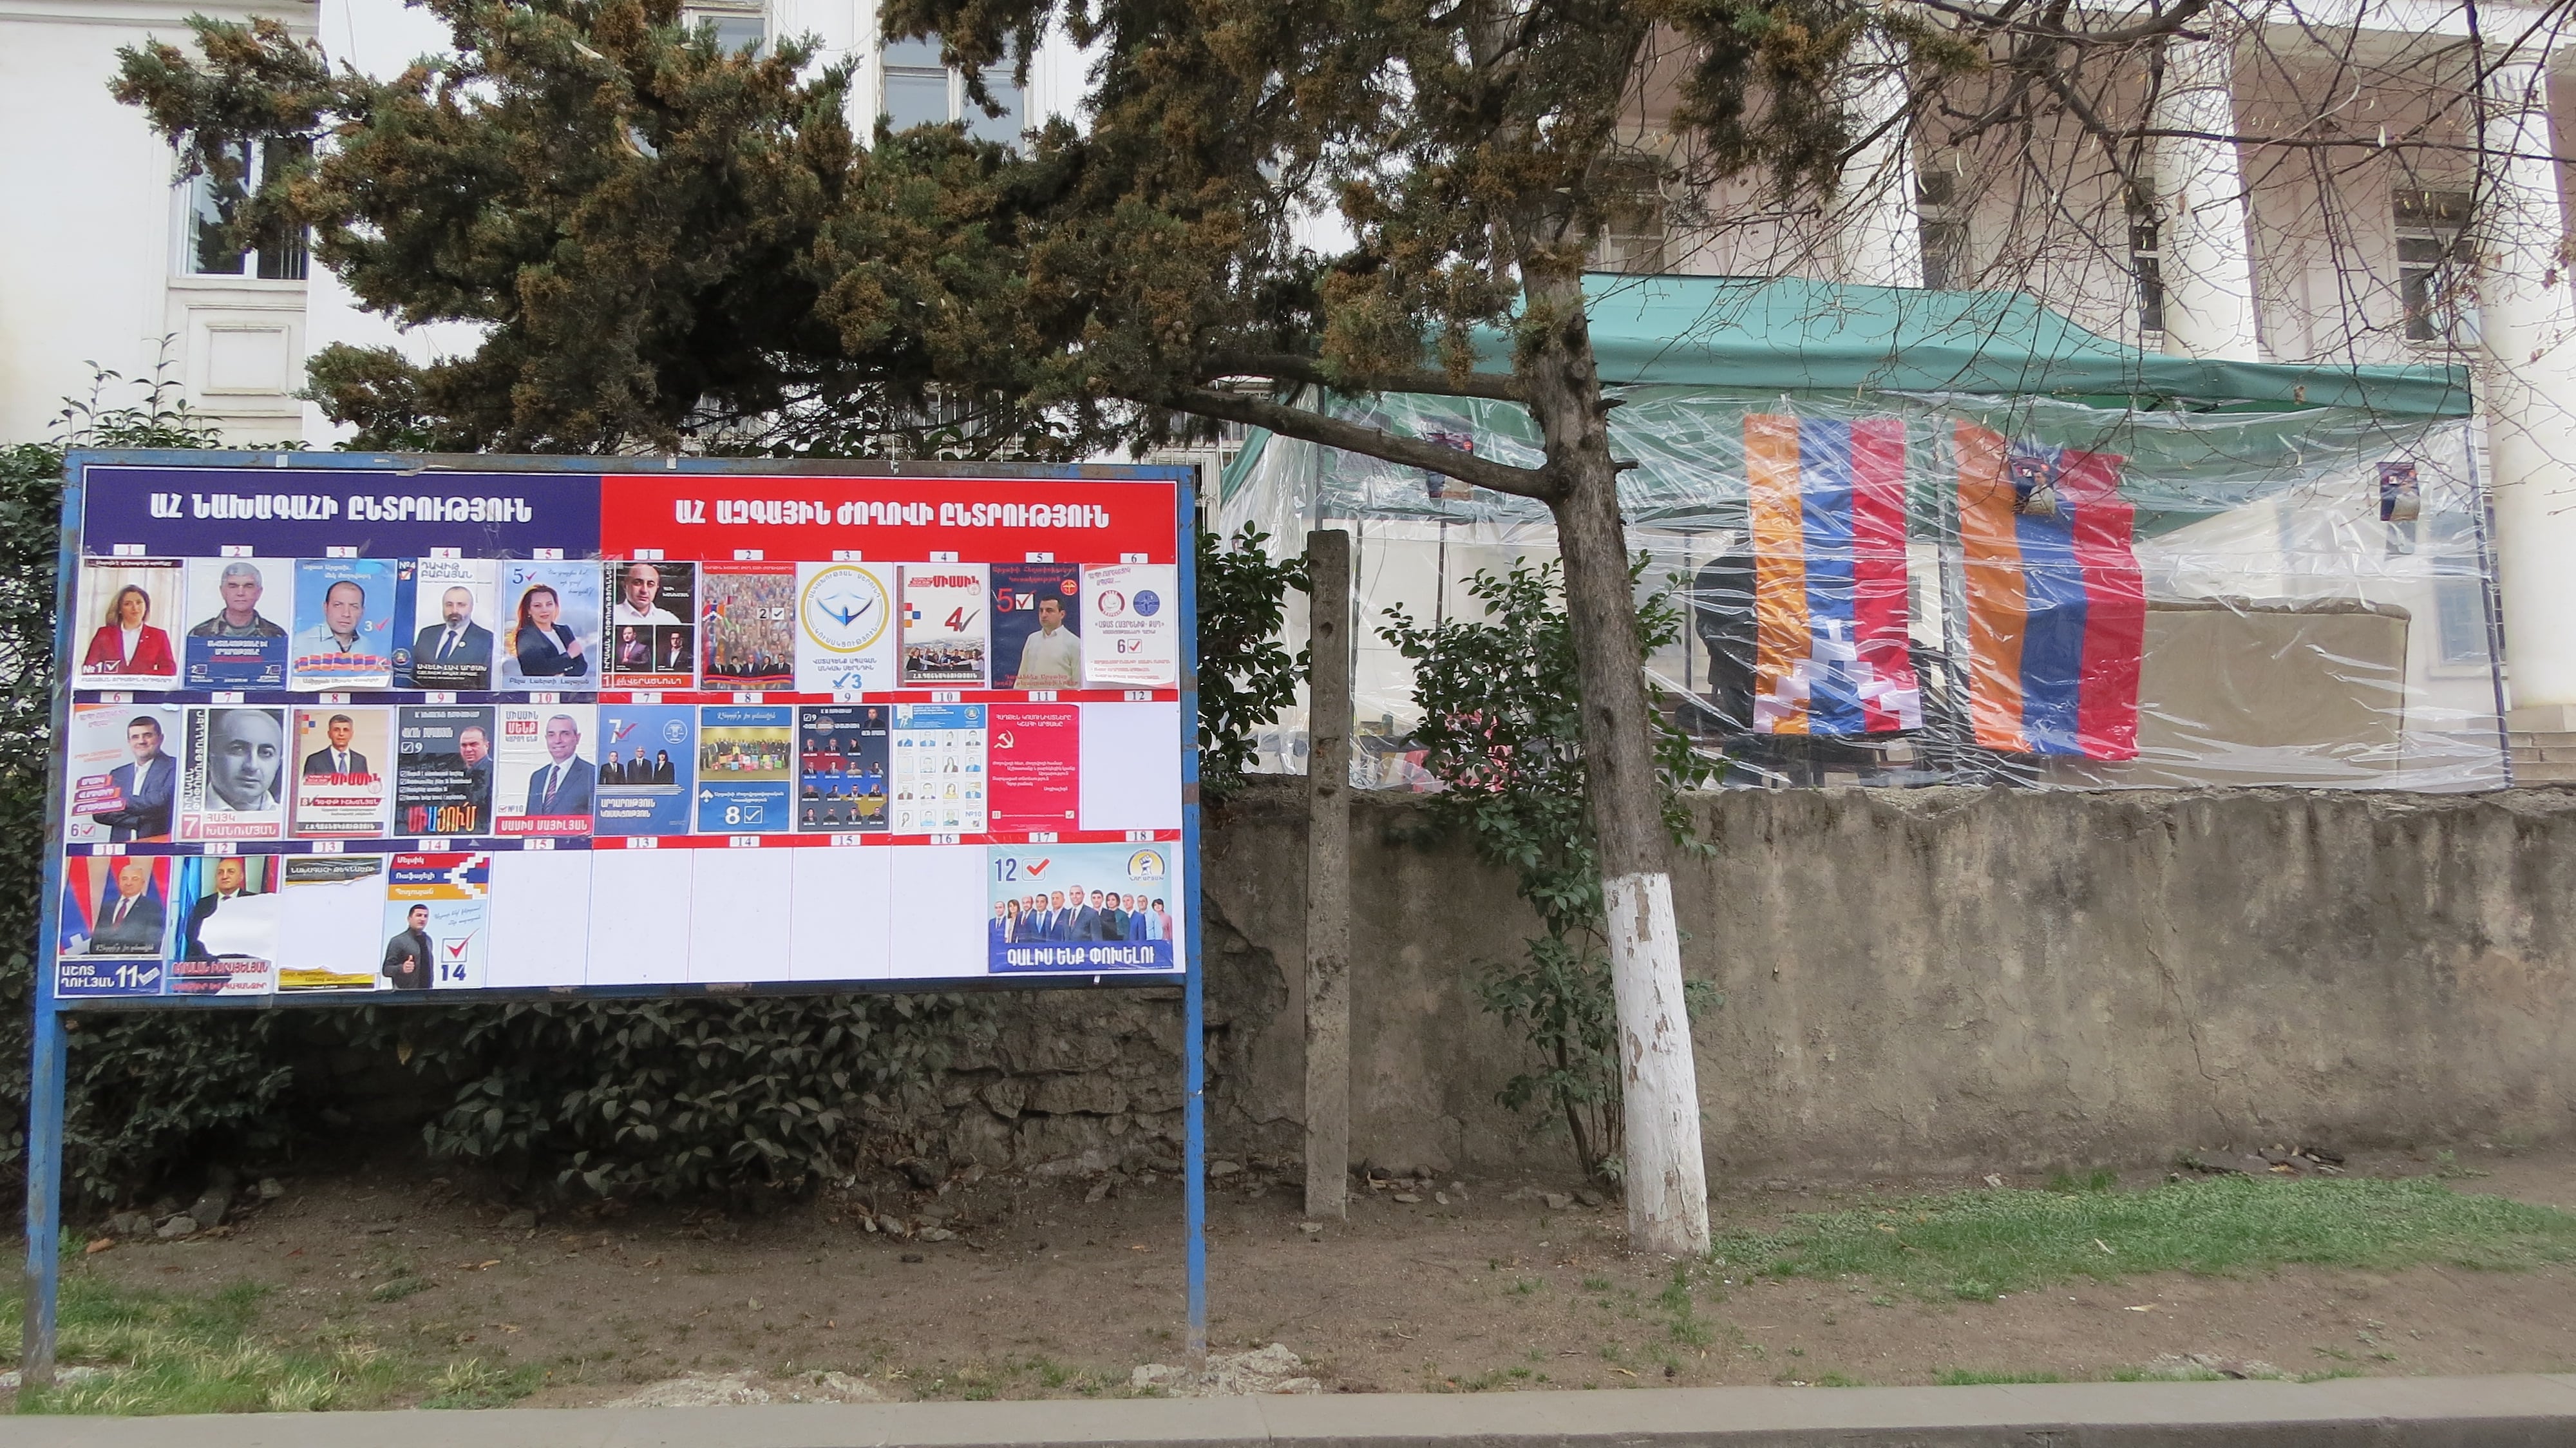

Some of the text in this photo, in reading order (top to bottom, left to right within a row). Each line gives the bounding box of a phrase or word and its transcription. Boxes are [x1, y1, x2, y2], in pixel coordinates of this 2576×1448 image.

[151, 493, 533, 523] ԱՀ ՆԱԽԱԳԱՀԻ ԸՆՏՐՈՒԹՅՈՒՆ
[676, 499, 1110, 528] ԱՀ ԱԶԳԱՅԻՆ ԺՈՂՈՎԻ ԸՆՏՐՈՒԹՅՈՒՆ
[128, 546, 132, 555] 1
[234, 546, 240, 555] 2
[340, 548, 345, 557] 3
[442, 549, 449, 557] 4
[545, 549, 551, 558] 5
[647, 551, 650, 559] 1
[746, 551, 752, 559] 2
[844, 551, 850, 560] 3
[1037, 553, 1043, 562] 5
[1132, 554, 1137, 563] 6
[421, 562, 459, 570] ԴԱՎԻԹ
[421, 570, 473, 578] ԲԱԲԱՅԱՆ
[513, 567, 524, 584] 5
[997, 588, 1013, 612] 5
[759, 609, 766, 618] 2
[945, 607, 963, 631] 4
[364, 621, 373, 631] 3
[1117, 639, 1126, 654] 6
[191, 665, 197, 674] 2
[265, 665, 270, 674] 7
[603, 676, 609, 687] 1
[851, 674, 862, 689] 3
[113, 693, 120, 701] 6
[225, 693, 231, 702] 7
[332, 694, 338, 703] 8
[438, 694, 444, 703] 9
[538, 693, 551, 703] 10
[644, 694, 650, 702] 7
[745, 693, 751, 702] 8
[844, 693, 851, 701] 9
[940, 692, 952, 701] 10
[1037, 692, 1049, 700] 11
[1132, 691, 1144, 700] 12
[506, 711, 538, 719] ՄԻԱՍԻՆ
[509, 722, 535, 733] ՄԵՆՔ
[609, 719, 622, 744] 7
[415, 742, 423, 753] 9
[207, 814, 236, 823] ՀԱՅԿ
[725, 806, 740, 824] 8
[184, 817, 198, 836] 7
[501, 819, 587, 831] ՄԱՍԻՍ ՄԱՅԻԼՅԱՆ
[71, 824, 79, 836] 6
[840, 835, 853, 844] 15
[939, 834, 951, 843] 16
[1037, 833, 1050, 843] 17
[1133, 831, 1146, 841] 18
[428, 841, 442, 850] 14
[532, 839, 547, 848] 15
[636, 838, 649, 847] 13
[738, 837, 752, 846] 14
[102, 844, 117, 854] 11
[213, 843, 228, 853] 12
[322, 842, 336, 852] 13
[995, 859, 1017, 881] 12
[1007, 946, 1154, 966] ԳԱԼԻՍ ԵՆՔ ՓՈԽԵԼՈՒ
[62, 966, 95, 976] ԱՇՈՏ
[441, 965, 466, 980] 14
[115, 965, 138, 988] 11
[61, 977, 115, 987] ՂՈՒԼՅԱՆ
